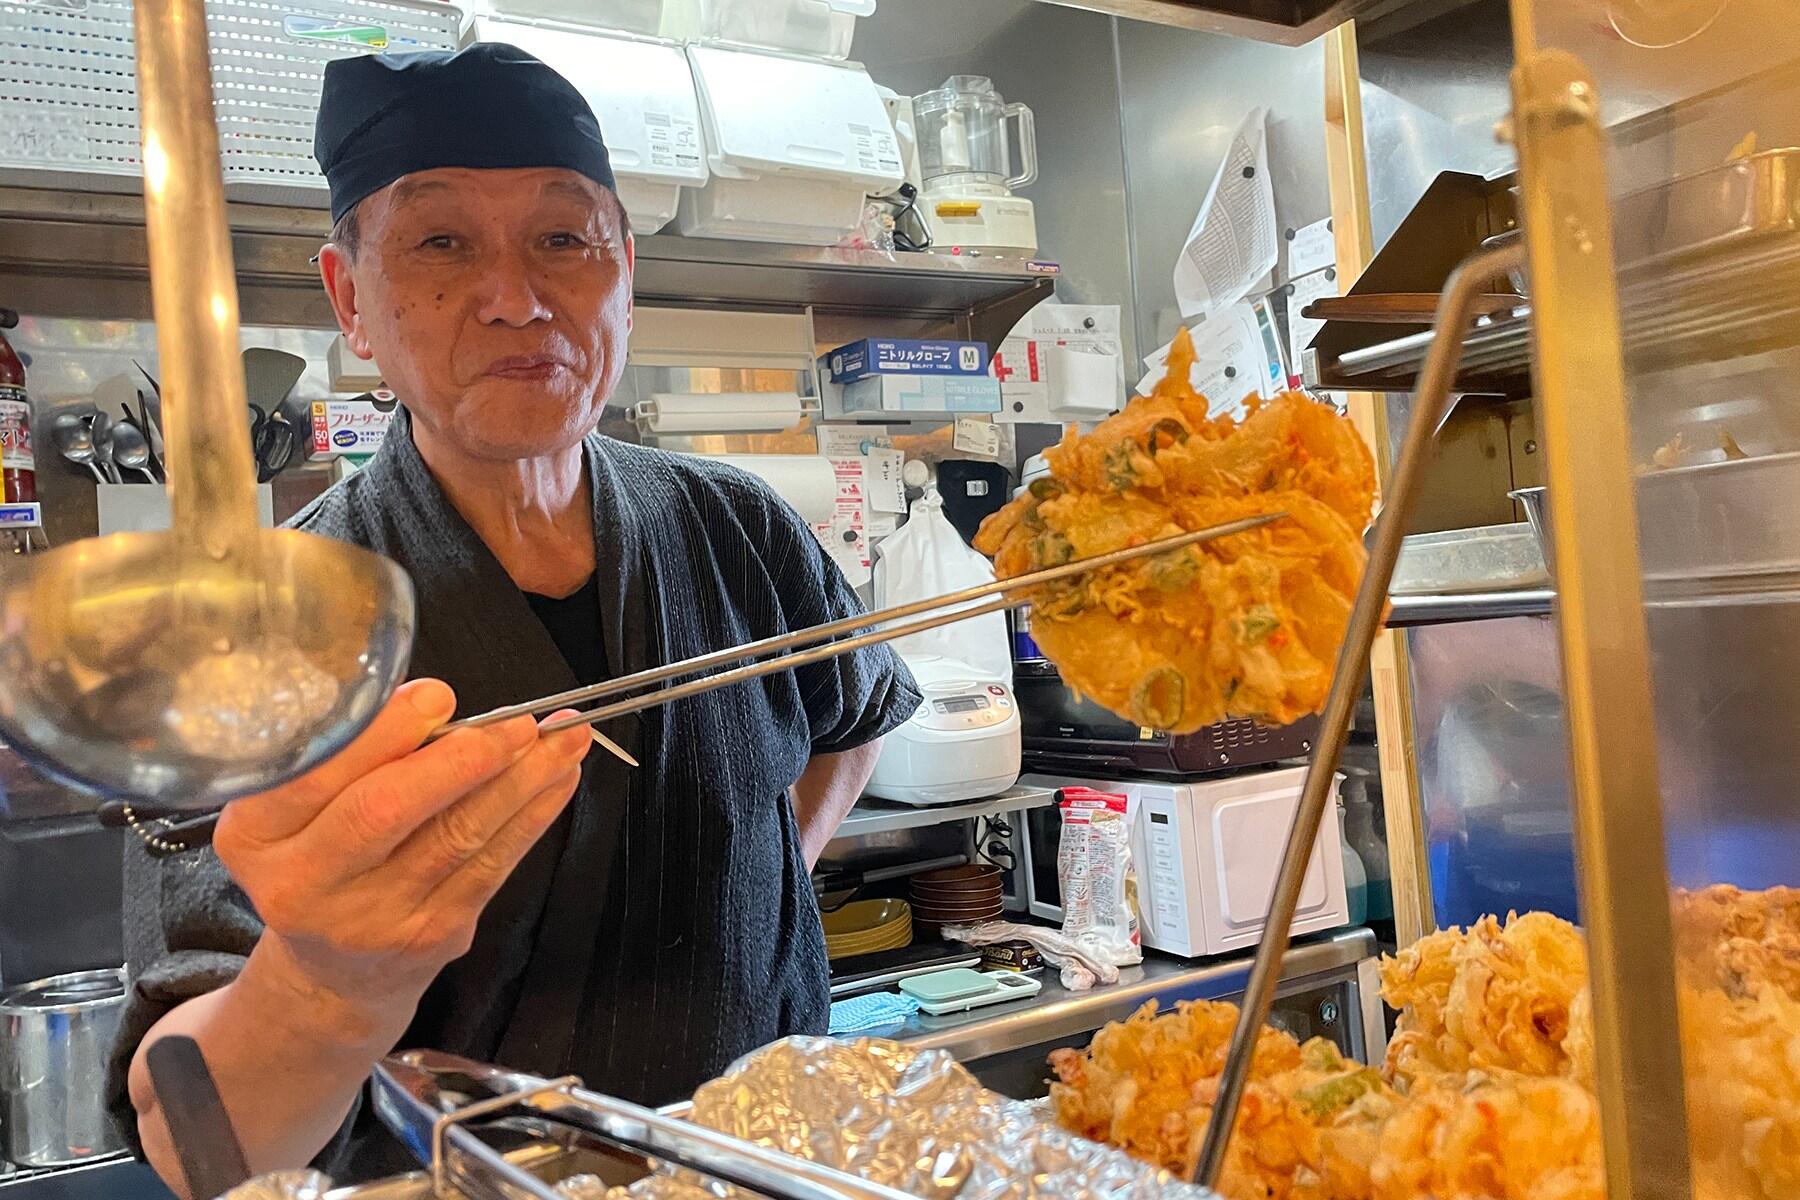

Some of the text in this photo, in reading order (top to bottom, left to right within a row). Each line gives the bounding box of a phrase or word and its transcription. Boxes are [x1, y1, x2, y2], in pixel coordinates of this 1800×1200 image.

[879, 350, 951, 362] ニトリルグローブ
[963, 351, 975, 363] M
[315, 404, 323, 414] S
